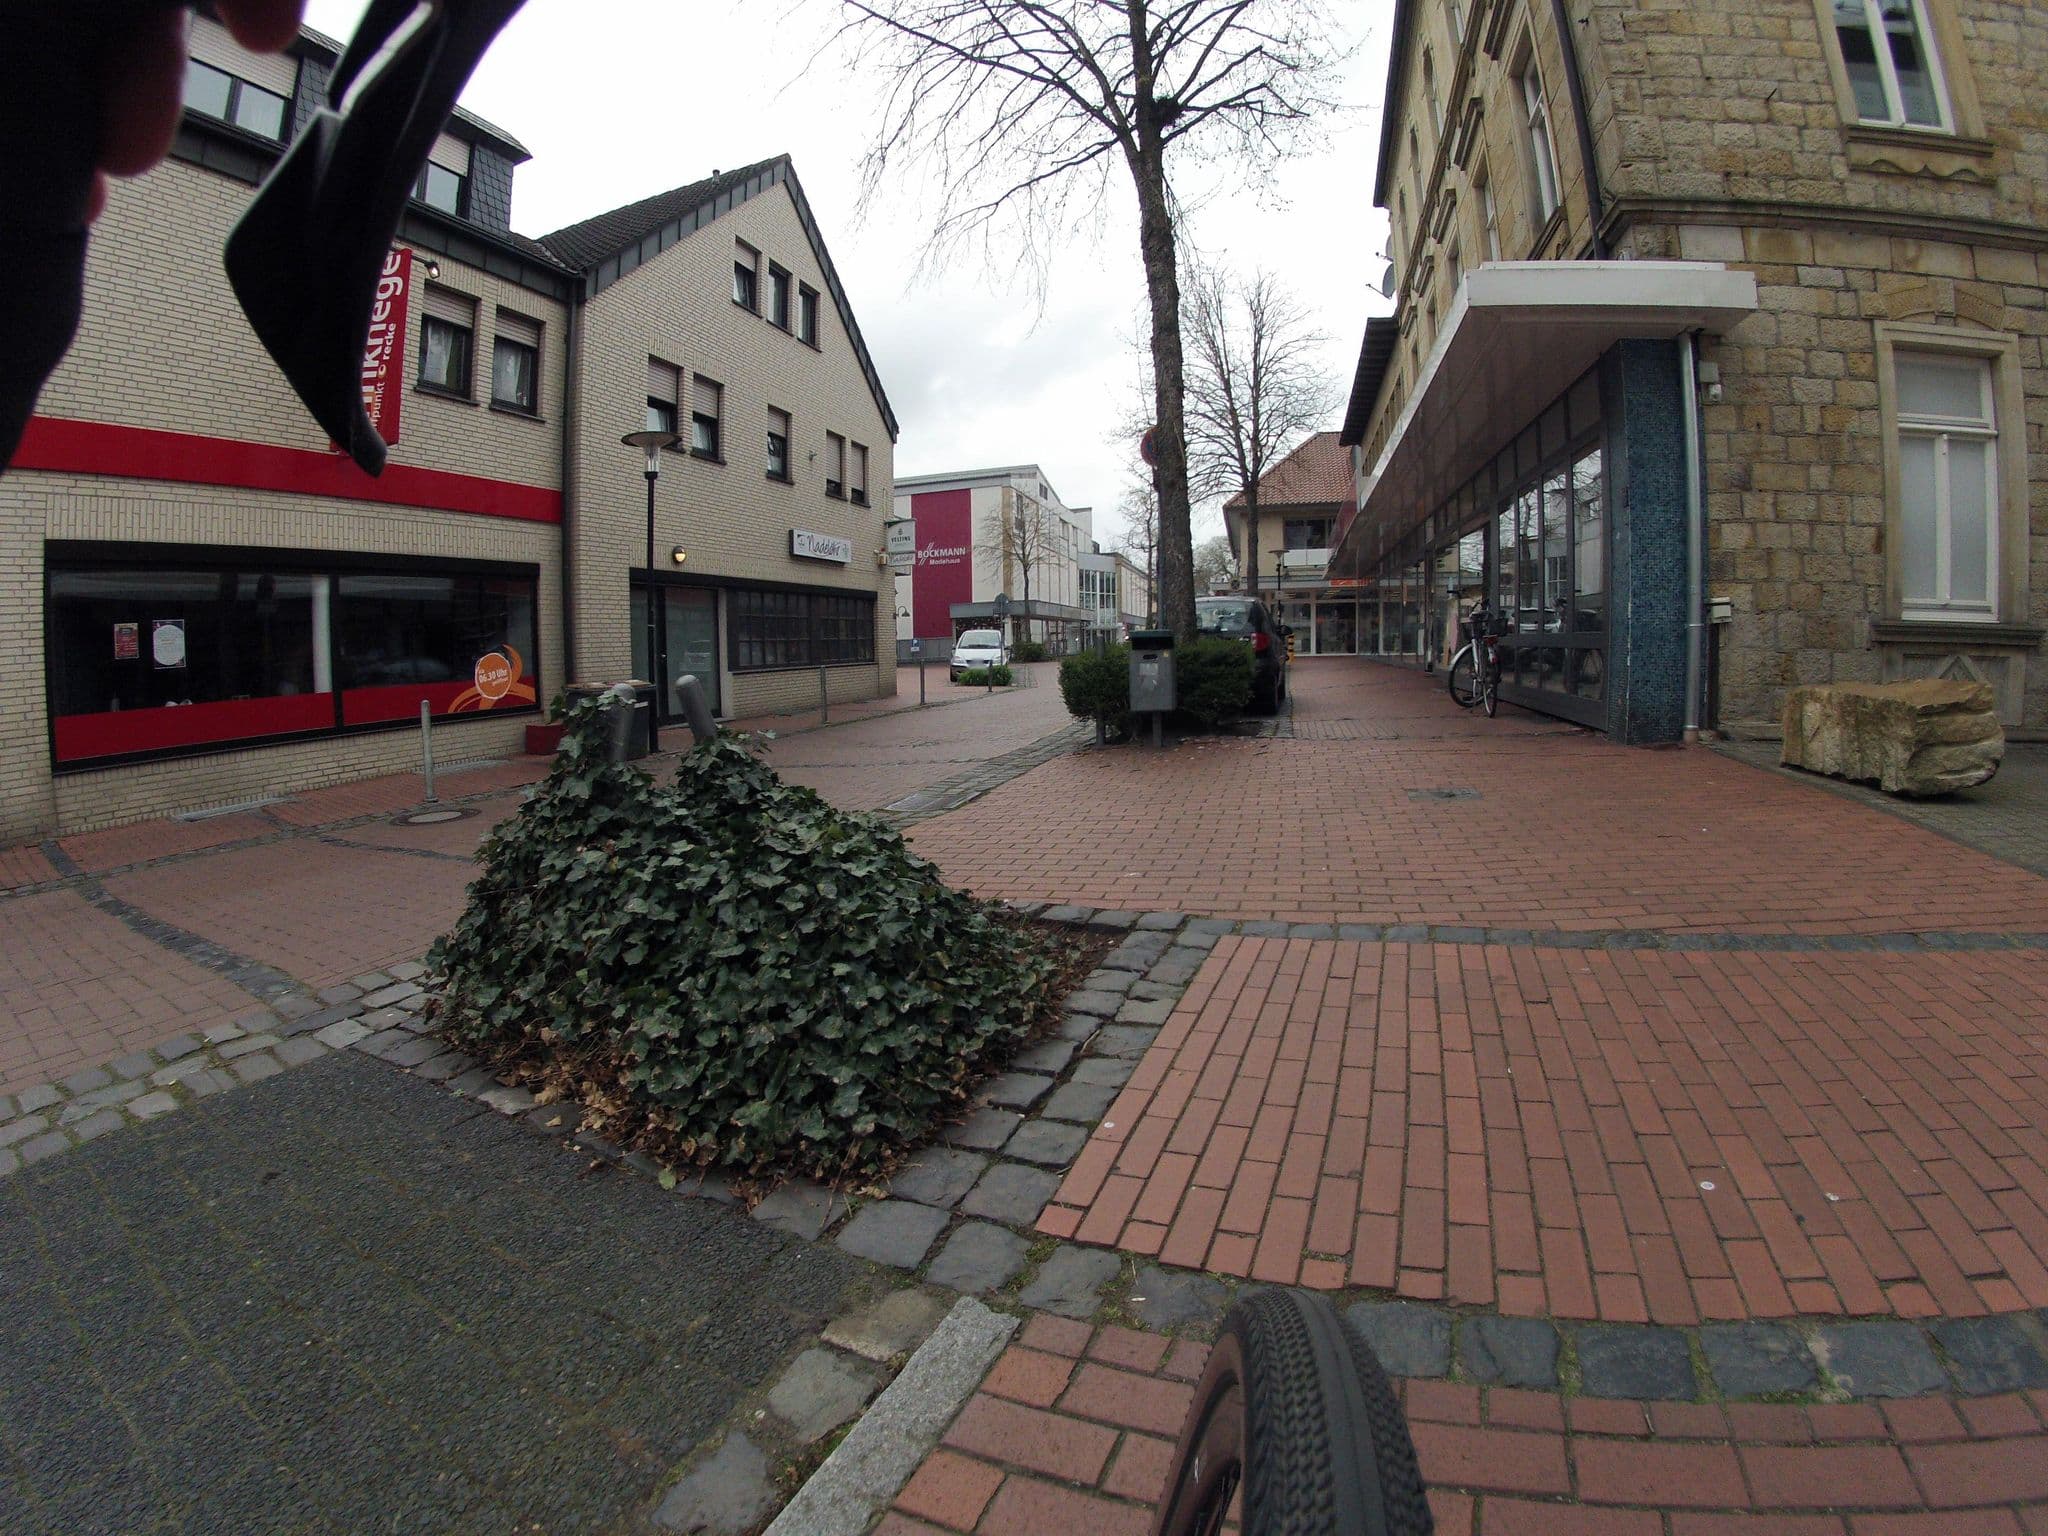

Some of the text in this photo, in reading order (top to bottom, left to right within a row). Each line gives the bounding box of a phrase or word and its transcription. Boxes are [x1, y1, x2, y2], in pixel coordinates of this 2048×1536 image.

[383, 323, 396, 360] recke
[929, 558, 961, 566] Modehaus
[496, 668, 507, 677] Uhr
